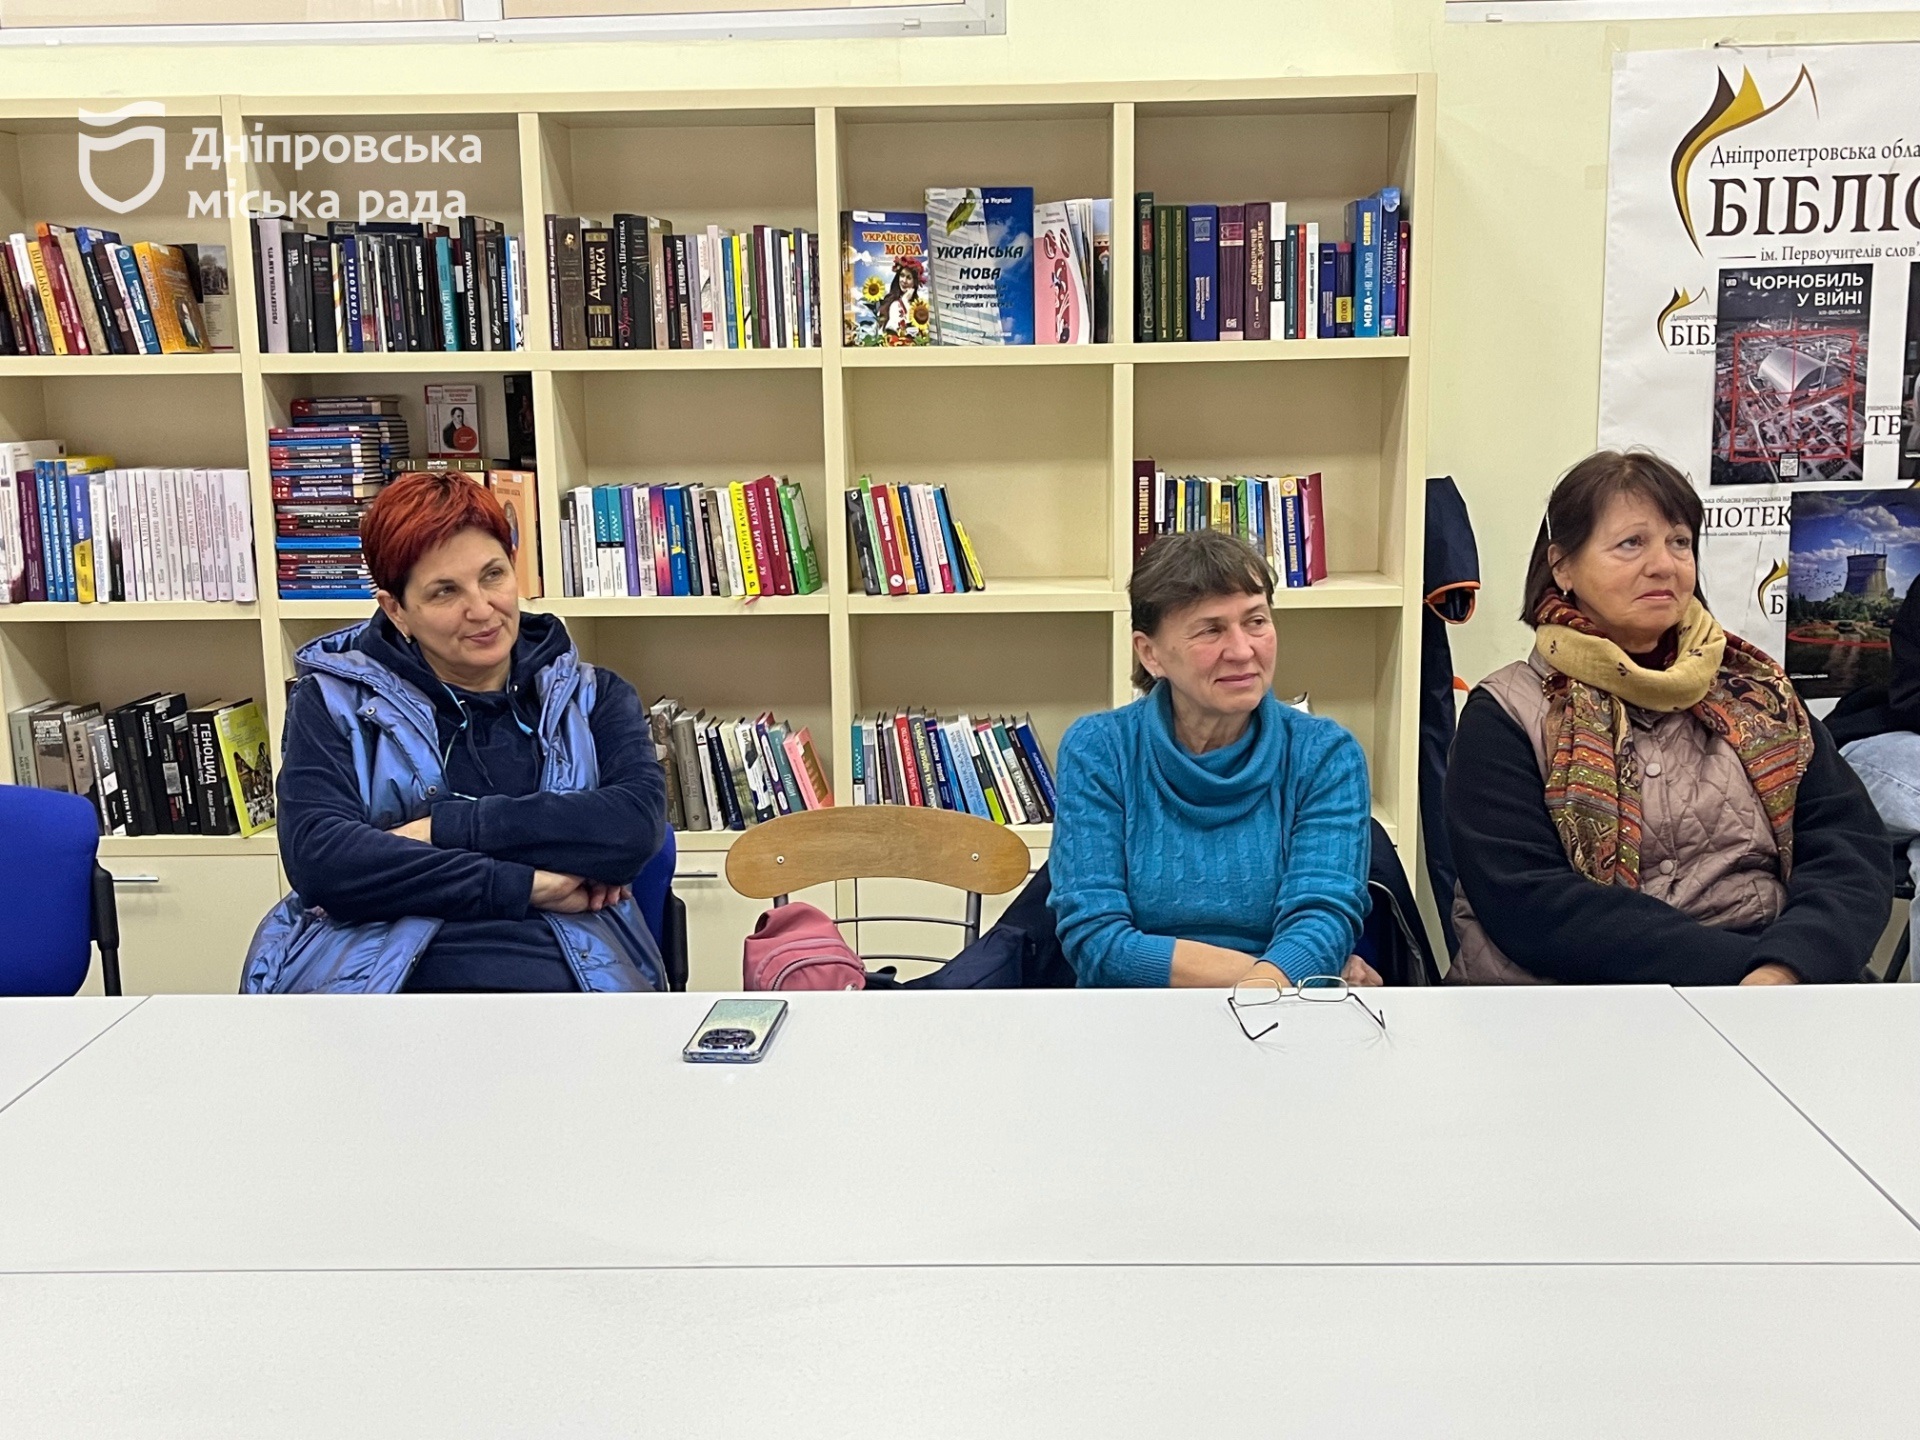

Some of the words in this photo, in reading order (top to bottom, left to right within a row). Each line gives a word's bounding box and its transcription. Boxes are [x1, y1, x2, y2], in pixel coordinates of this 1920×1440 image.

[1710, 144, 1877, 169] Дніпропетровська
[862, 231, 922, 243] УКРАЇНСЬКА
[884, 244, 922, 256] МОВА
[936, 243, 1023, 260] УКРАЇНСЬКА
[1760, 247, 1778, 262] ім.
[1782, 244, 1882, 265] Первоучителів
[1885, 241, 1920, 257] слов'
[596, 248, 606, 287] ТАРАСА
[1384, 241, 1394, 283] СЛОВНИК
[959, 267, 1001, 280] МОВА
[1750, 272, 1864, 290] ЧОРНОБИЛЬ
[1796, 292, 1810, 307] У
[1814, 288, 1863, 306] ВІЙНІ
[1363, 297, 1372, 327] МОВА
[200, 723, 217, 784] ГЕНОЦИД
